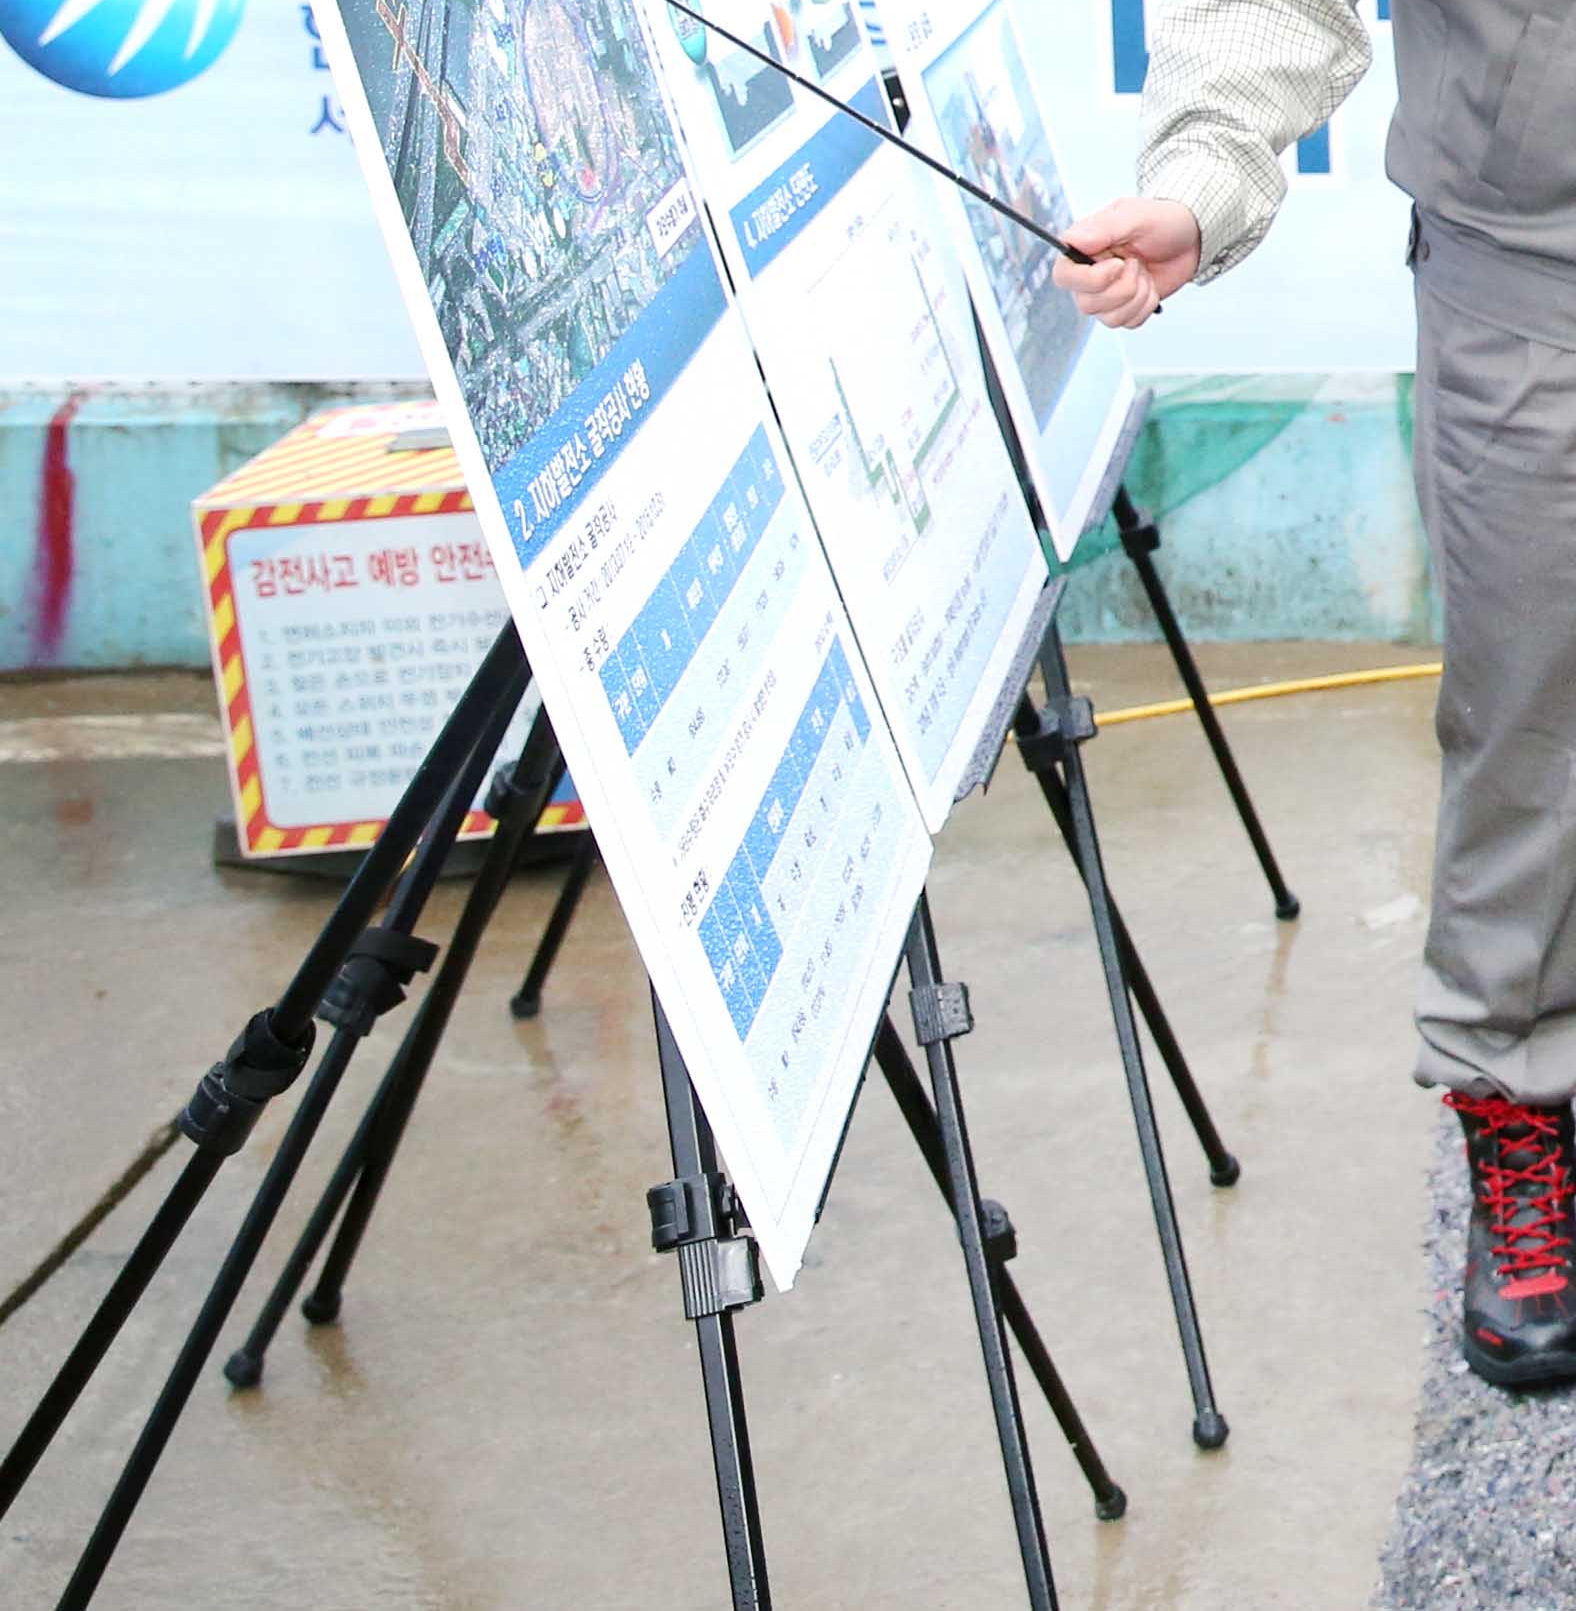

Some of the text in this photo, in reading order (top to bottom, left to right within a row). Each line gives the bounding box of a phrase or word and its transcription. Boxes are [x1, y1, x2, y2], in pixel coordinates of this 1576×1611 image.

[513, 359, 650, 541] 2. 지하발전소 굴착공사 현황
[251, 553, 358, 599] 감전사고
[369, 548, 419, 587] 예방
[545, 504, 617, 594] 지하발전소 굴착공사
